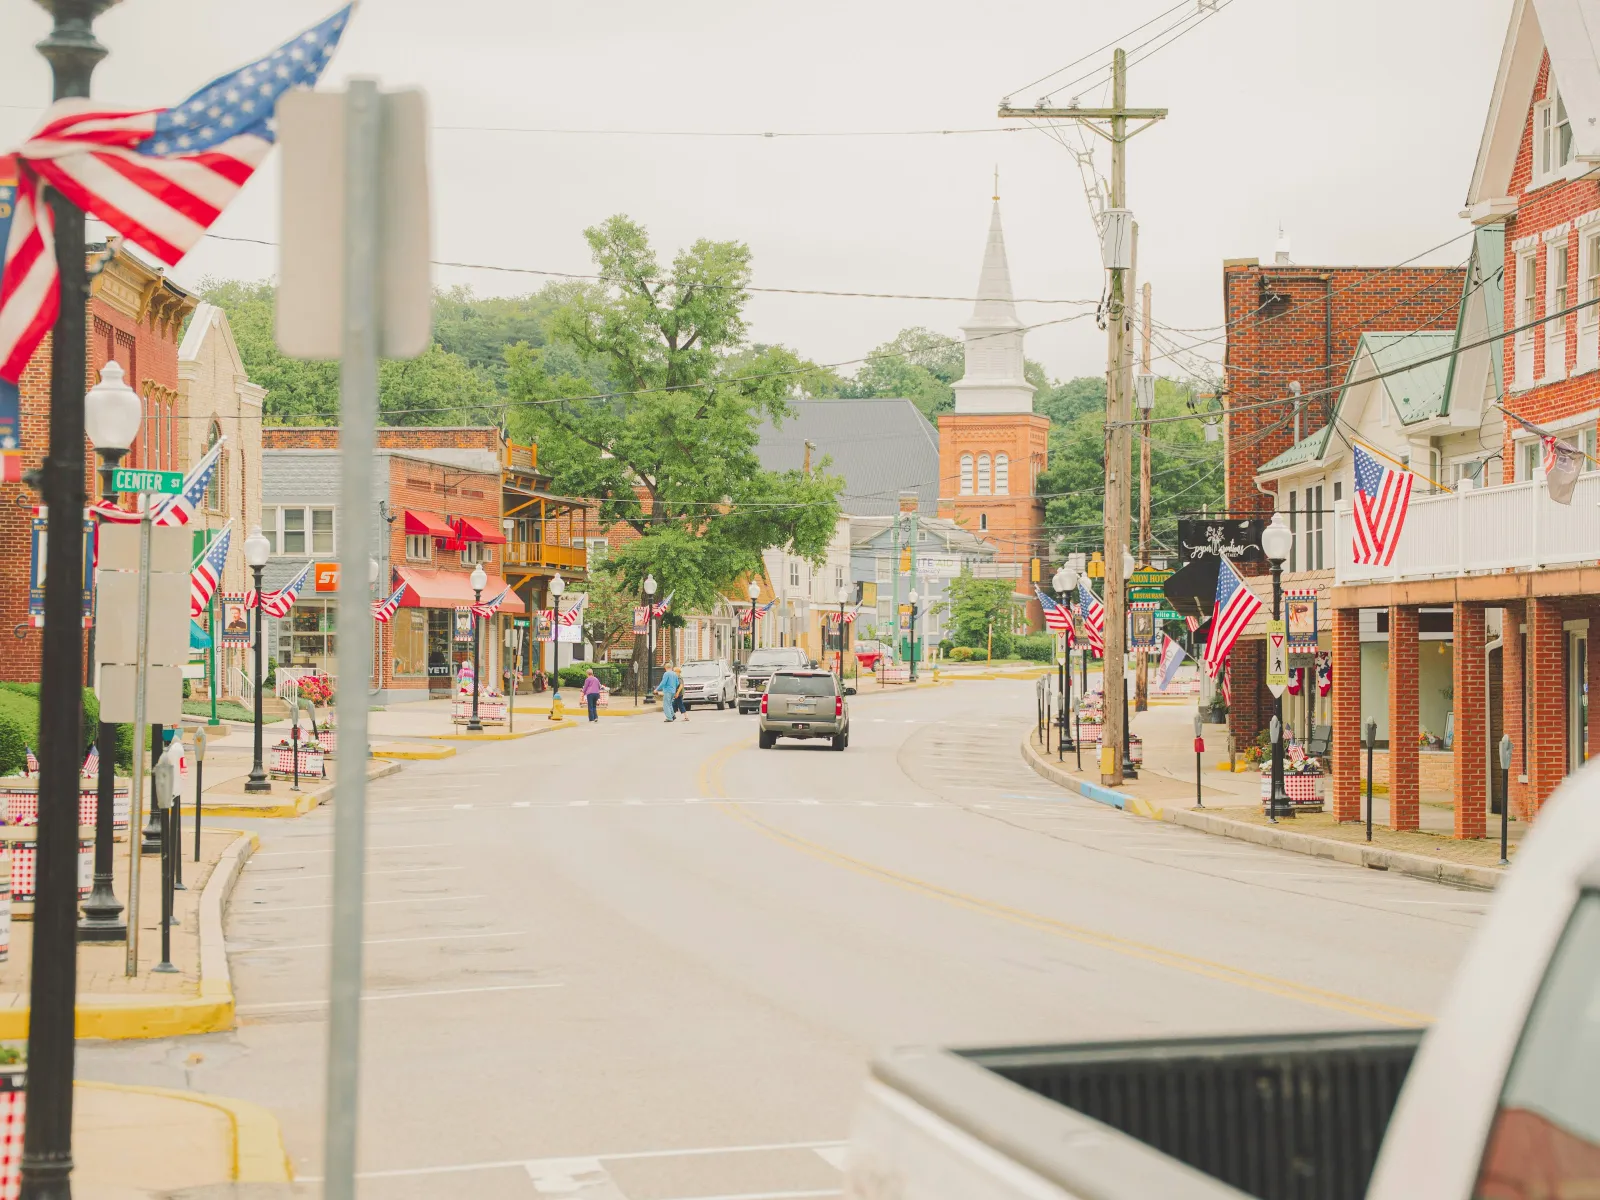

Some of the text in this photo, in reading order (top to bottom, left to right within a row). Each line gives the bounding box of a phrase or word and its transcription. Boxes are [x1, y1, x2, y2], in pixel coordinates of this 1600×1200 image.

[116, 471, 180, 490] CENTER ST
[917, 558, 933, 566] ITE
[1131, 574, 1169, 583] NION HOTE
[428, 666, 448, 674] YETI
